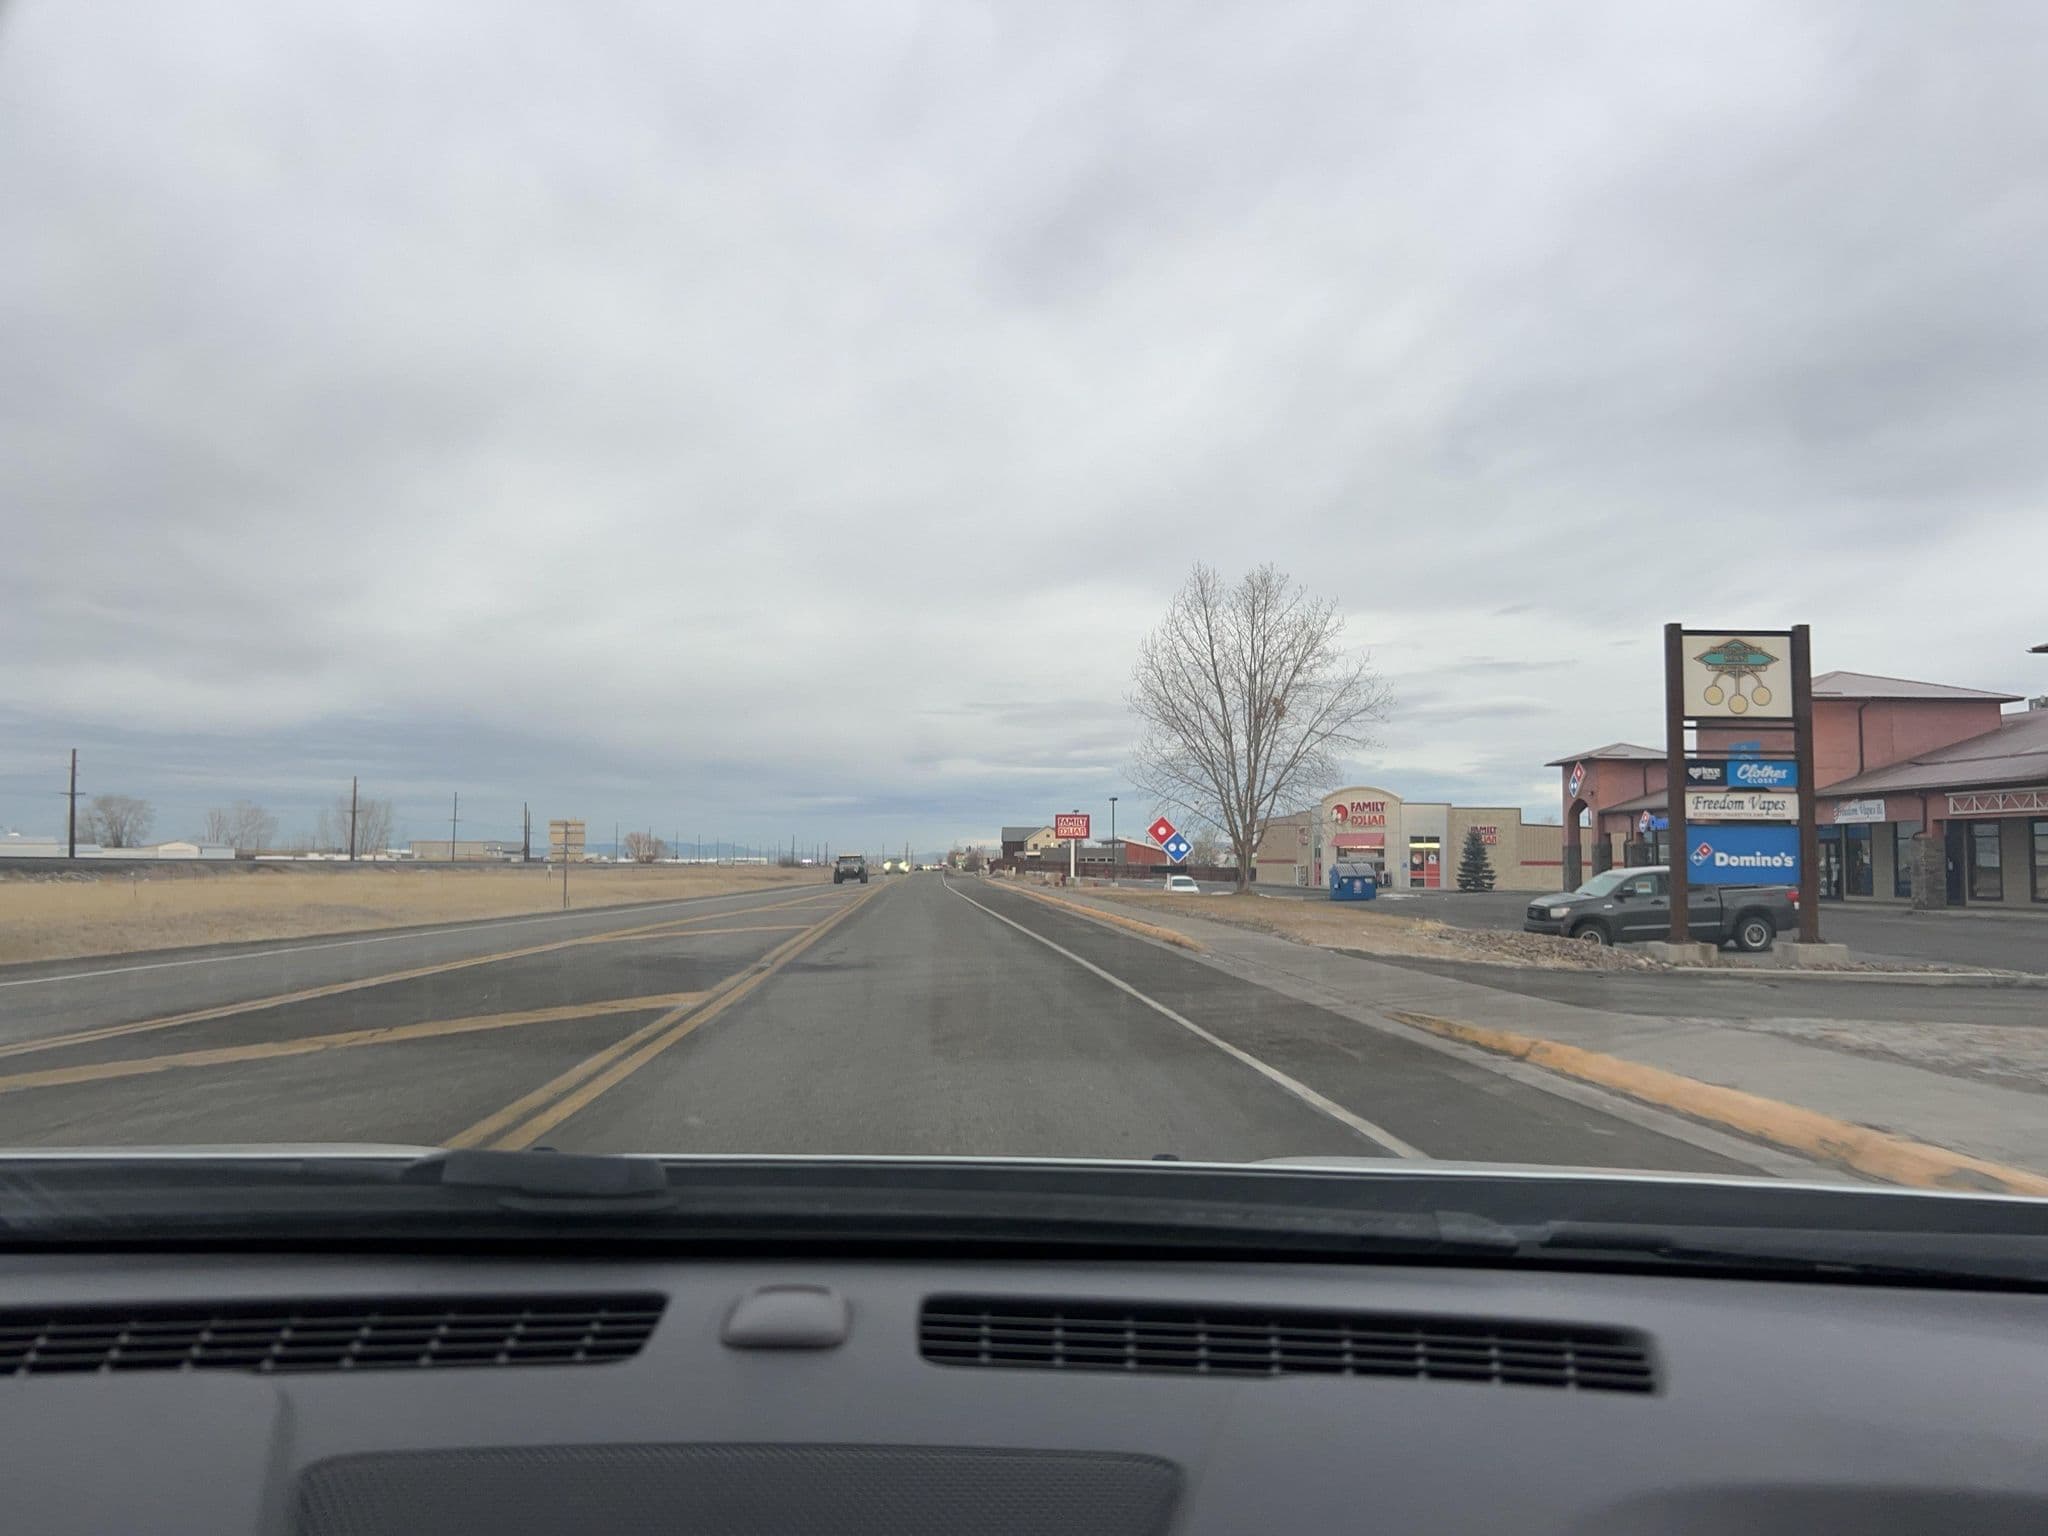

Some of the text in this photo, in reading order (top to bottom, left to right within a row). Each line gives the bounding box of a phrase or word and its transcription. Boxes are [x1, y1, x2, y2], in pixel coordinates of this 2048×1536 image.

[1737, 764, 1787, 779] Clothes
[1350, 802, 1385, 811] FAMILY
[1692, 794, 1786, 815] Freedom Vapes
[1058, 818, 1086, 827] FAMILY
[1351, 815, 1385, 826] DOLLAR
[1715, 851, 1793, 867] Domino's
